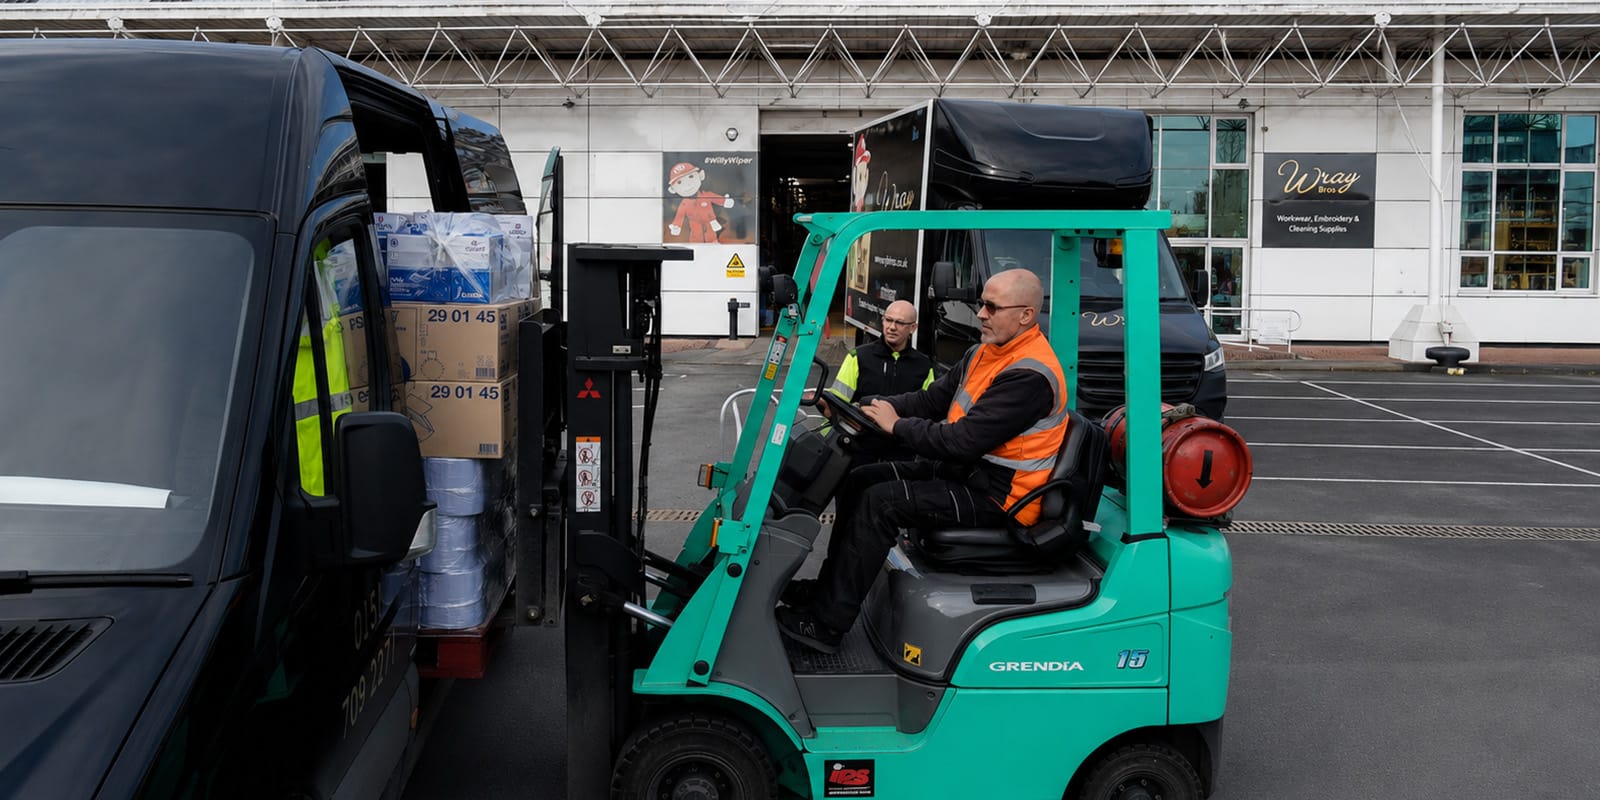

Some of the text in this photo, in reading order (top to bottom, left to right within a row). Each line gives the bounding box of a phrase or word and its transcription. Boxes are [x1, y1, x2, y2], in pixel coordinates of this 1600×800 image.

[704, 156, 753, 165] #WillyWiper
[1277, 159, 1361, 194] Wray
[1318, 186, 1336, 194] Bros
[1277, 215, 1313, 223] Workwear,
[1314, 215, 1353, 224] Embroidery
[1288, 225, 1347, 234] Cleaning Supplies
[428, 309, 447, 323] 29
[451, 309, 470, 323] 01
[475, 310, 496, 323] 45
[431, 385, 450, 399] 29
[455, 385, 473, 399] 01
[478, 386, 499, 400] 45
[988, 649, 1150, 672] GRENDIA 15
[342, 674, 366, 740] 709
